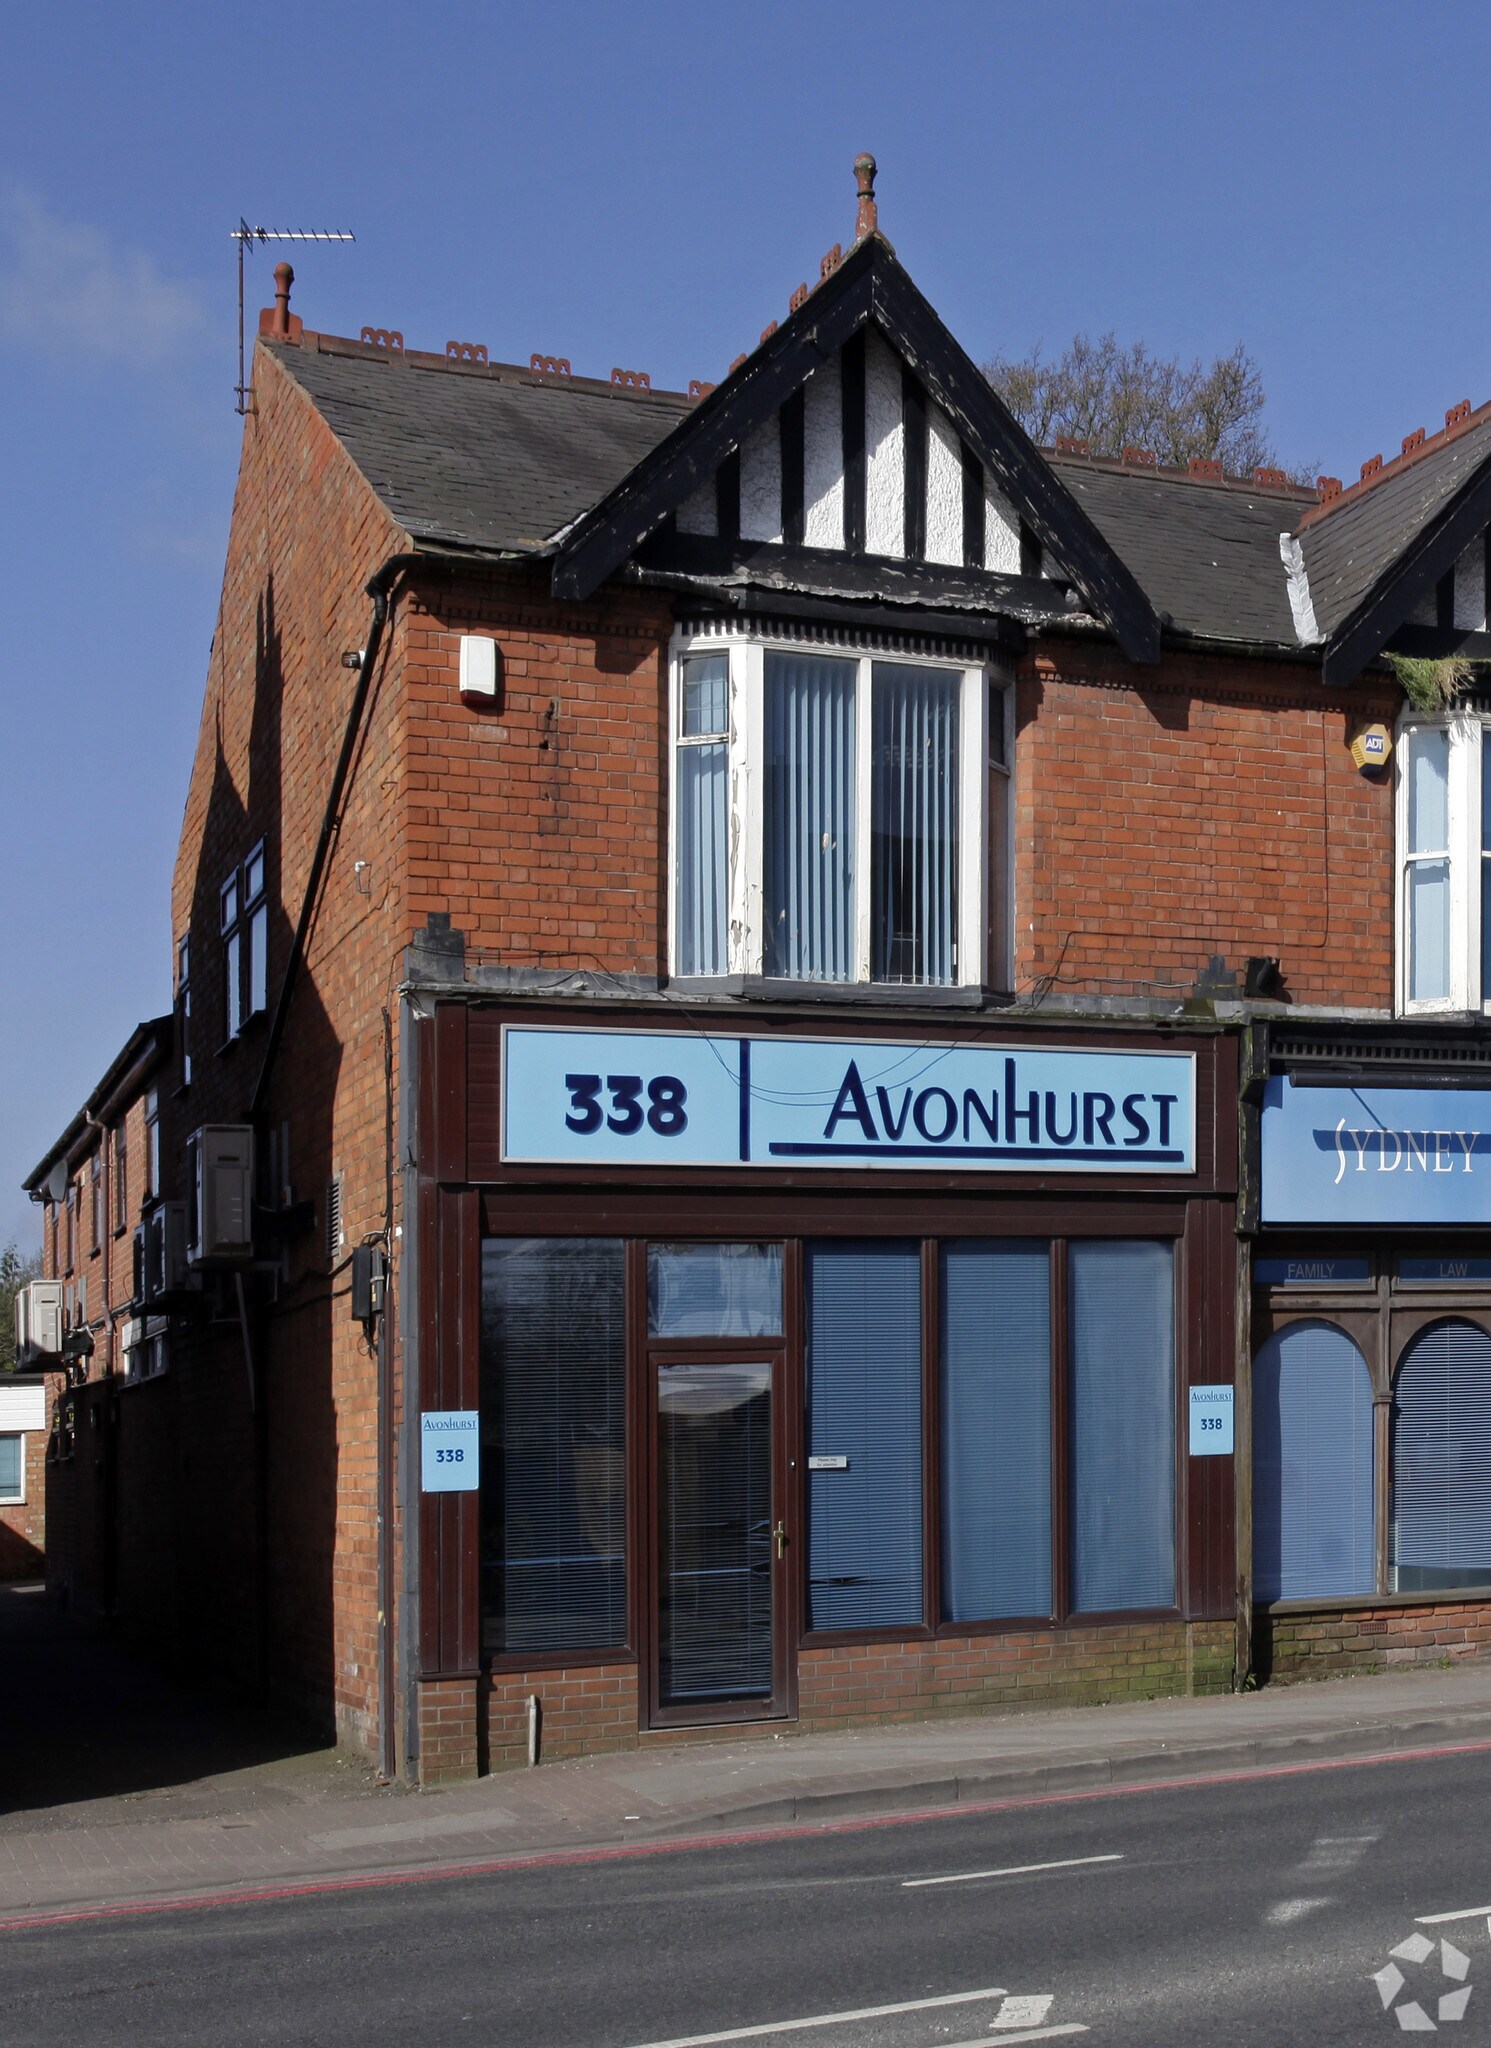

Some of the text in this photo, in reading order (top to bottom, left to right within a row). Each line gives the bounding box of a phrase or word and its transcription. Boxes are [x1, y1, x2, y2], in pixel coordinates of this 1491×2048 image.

[1365, 737, 1384, 750] ADT
[564, 1057, 1178, 1147] 338 AVONHURST
[1334, 1117, 1481, 1185] SYDNEY
[1287, 1262, 1468, 1279] FAMILY LAW
[1191, 1390, 1232, 1402] AVONHURST
[423, 1417, 476, 1429] AVONHURST
[1200, 1418, 1223, 1431] 338
[436, 1448, 464, 1463] 338
